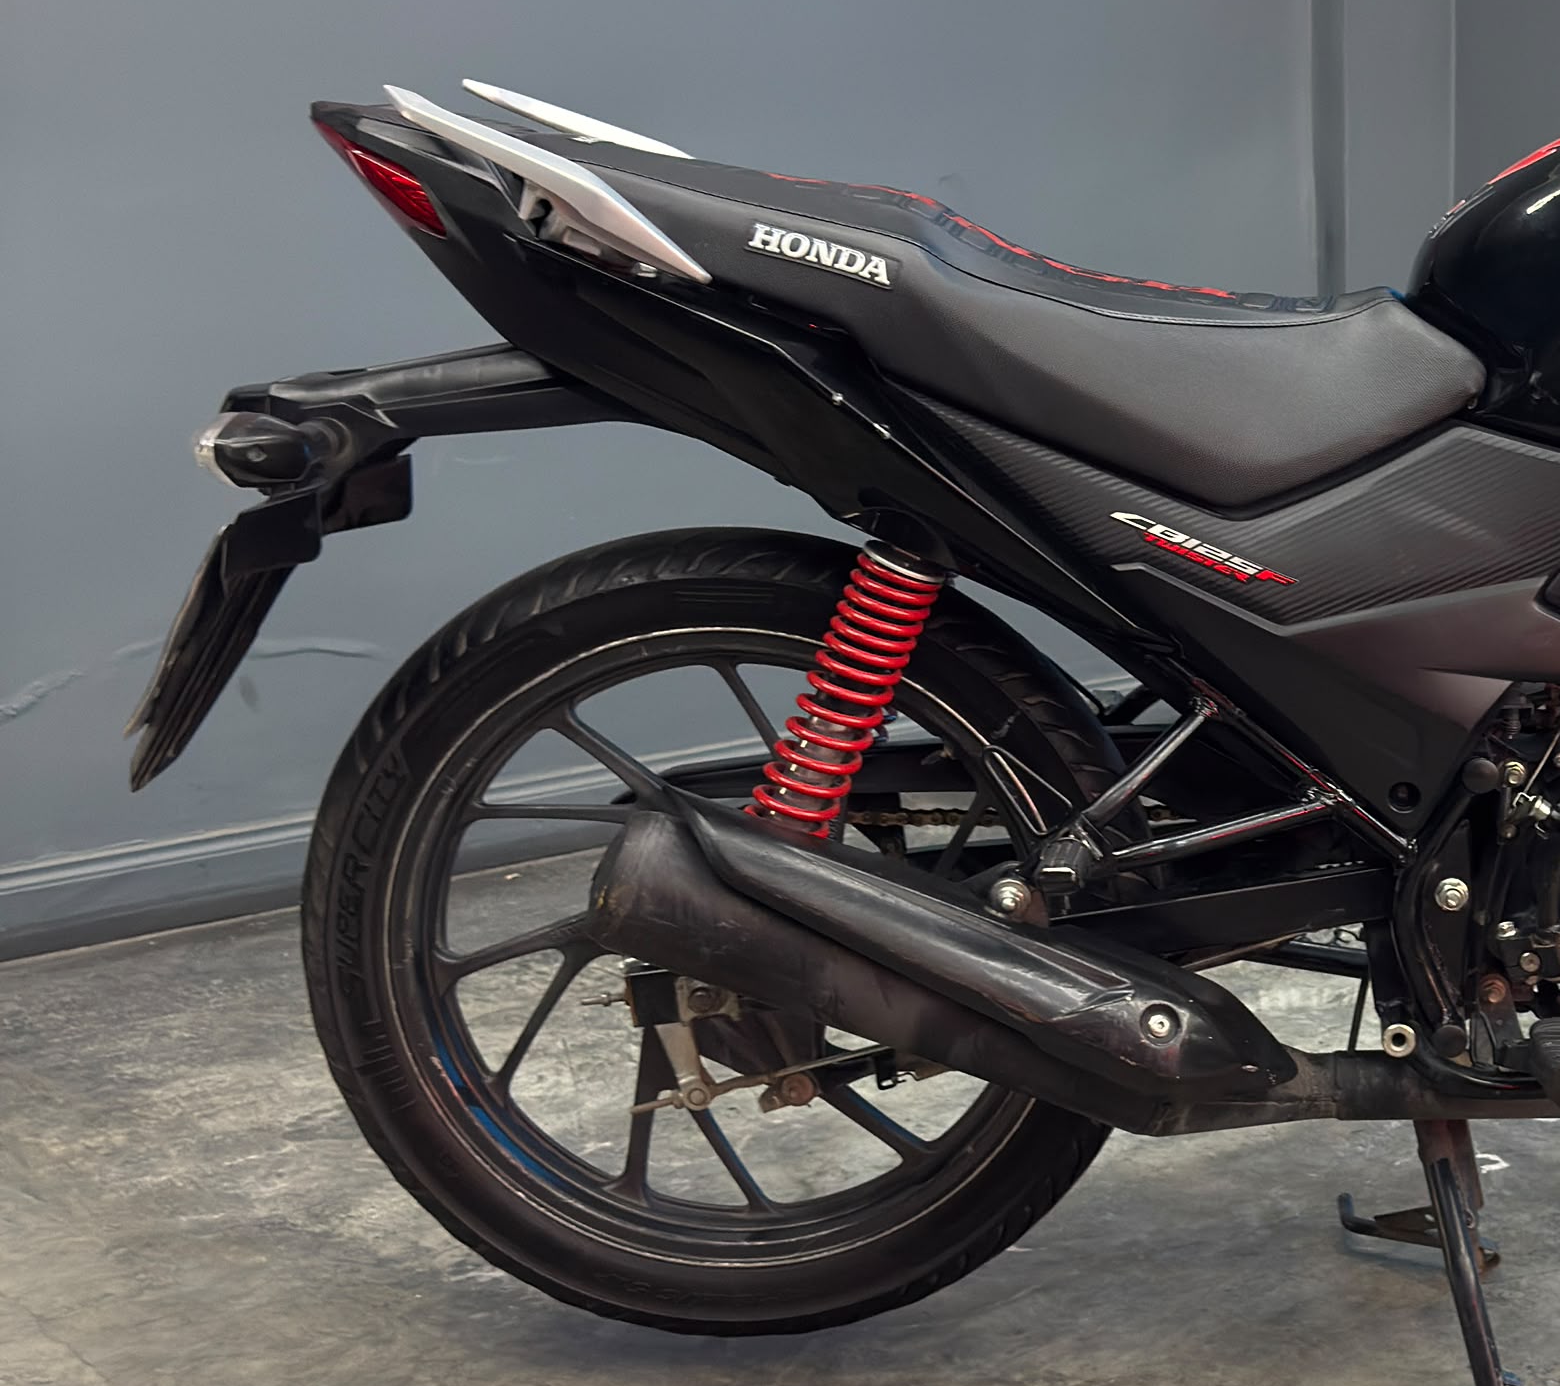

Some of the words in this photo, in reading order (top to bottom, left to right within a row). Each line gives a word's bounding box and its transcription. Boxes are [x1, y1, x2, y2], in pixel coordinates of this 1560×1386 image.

[748, 223, 891, 285] HONDA
[1109, 511, 1297, 586] CB125F
[1143, 531, 1251, 584] TWISTER
